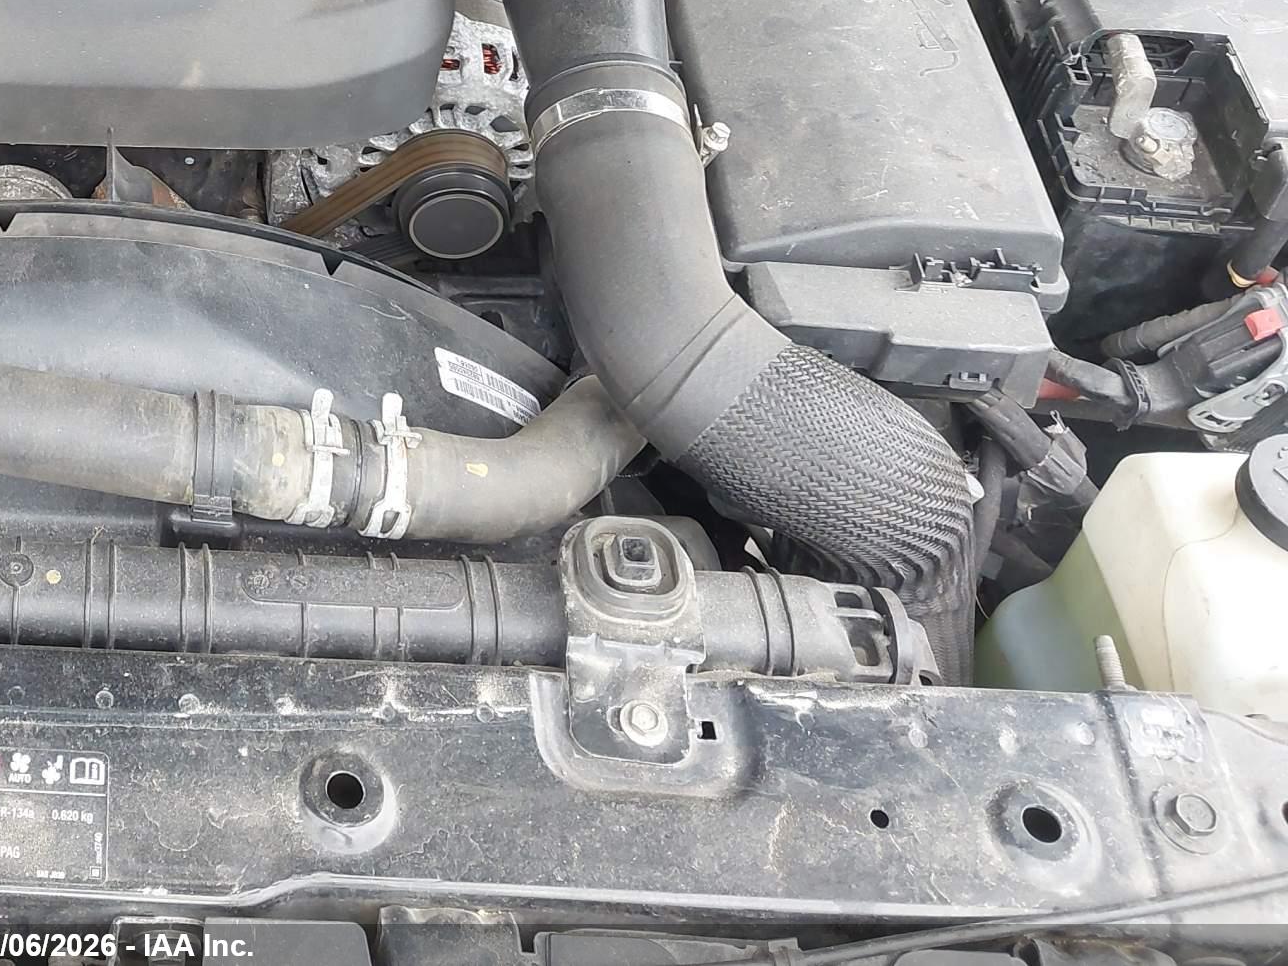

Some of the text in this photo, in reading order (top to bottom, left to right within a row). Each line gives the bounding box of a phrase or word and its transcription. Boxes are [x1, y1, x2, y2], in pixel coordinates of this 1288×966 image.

[8, 773, 32, 784] AUTO
[0, 807, 35, 820] R-134a
[80, 810, 94, 825] kg
[0, 845, 21, 859] PAG
